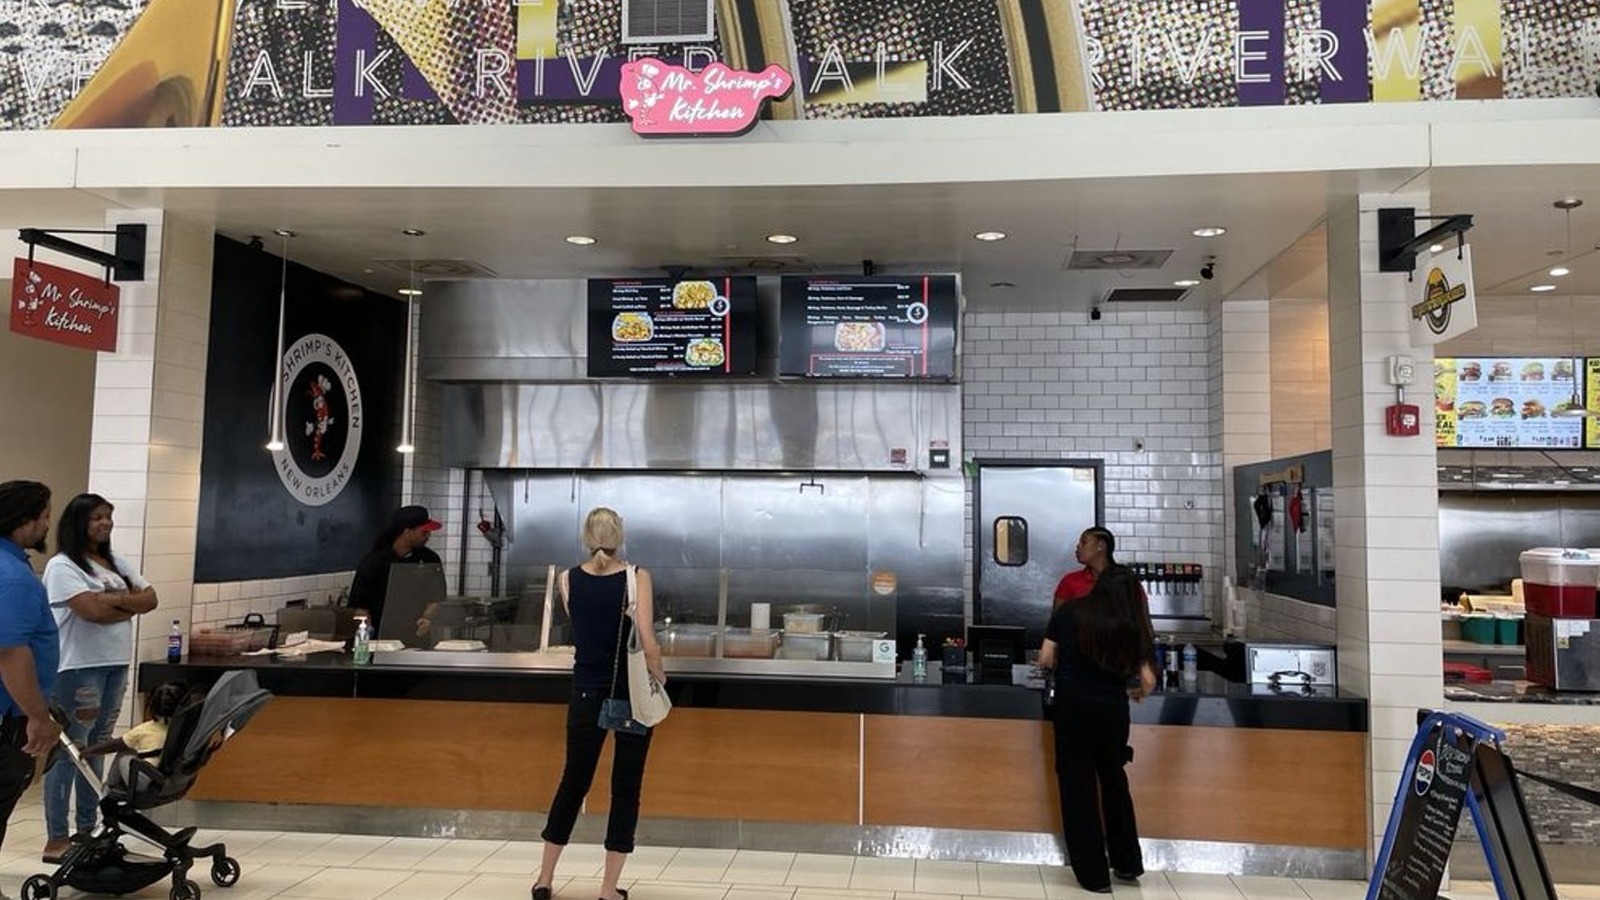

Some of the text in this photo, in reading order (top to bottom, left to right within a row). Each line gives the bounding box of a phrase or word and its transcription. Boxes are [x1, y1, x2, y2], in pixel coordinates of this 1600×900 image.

[661, 68, 783, 99] Mr. Shrimp's
[669, 97, 745, 123] Kitchen
[41, 283, 116, 320] Mr. Shrimp's
[45, 306, 92, 334] Kitchen
[334, 351, 360, 429] KITCHEN
[280, 458, 350, 498] NEW ORLEANS
